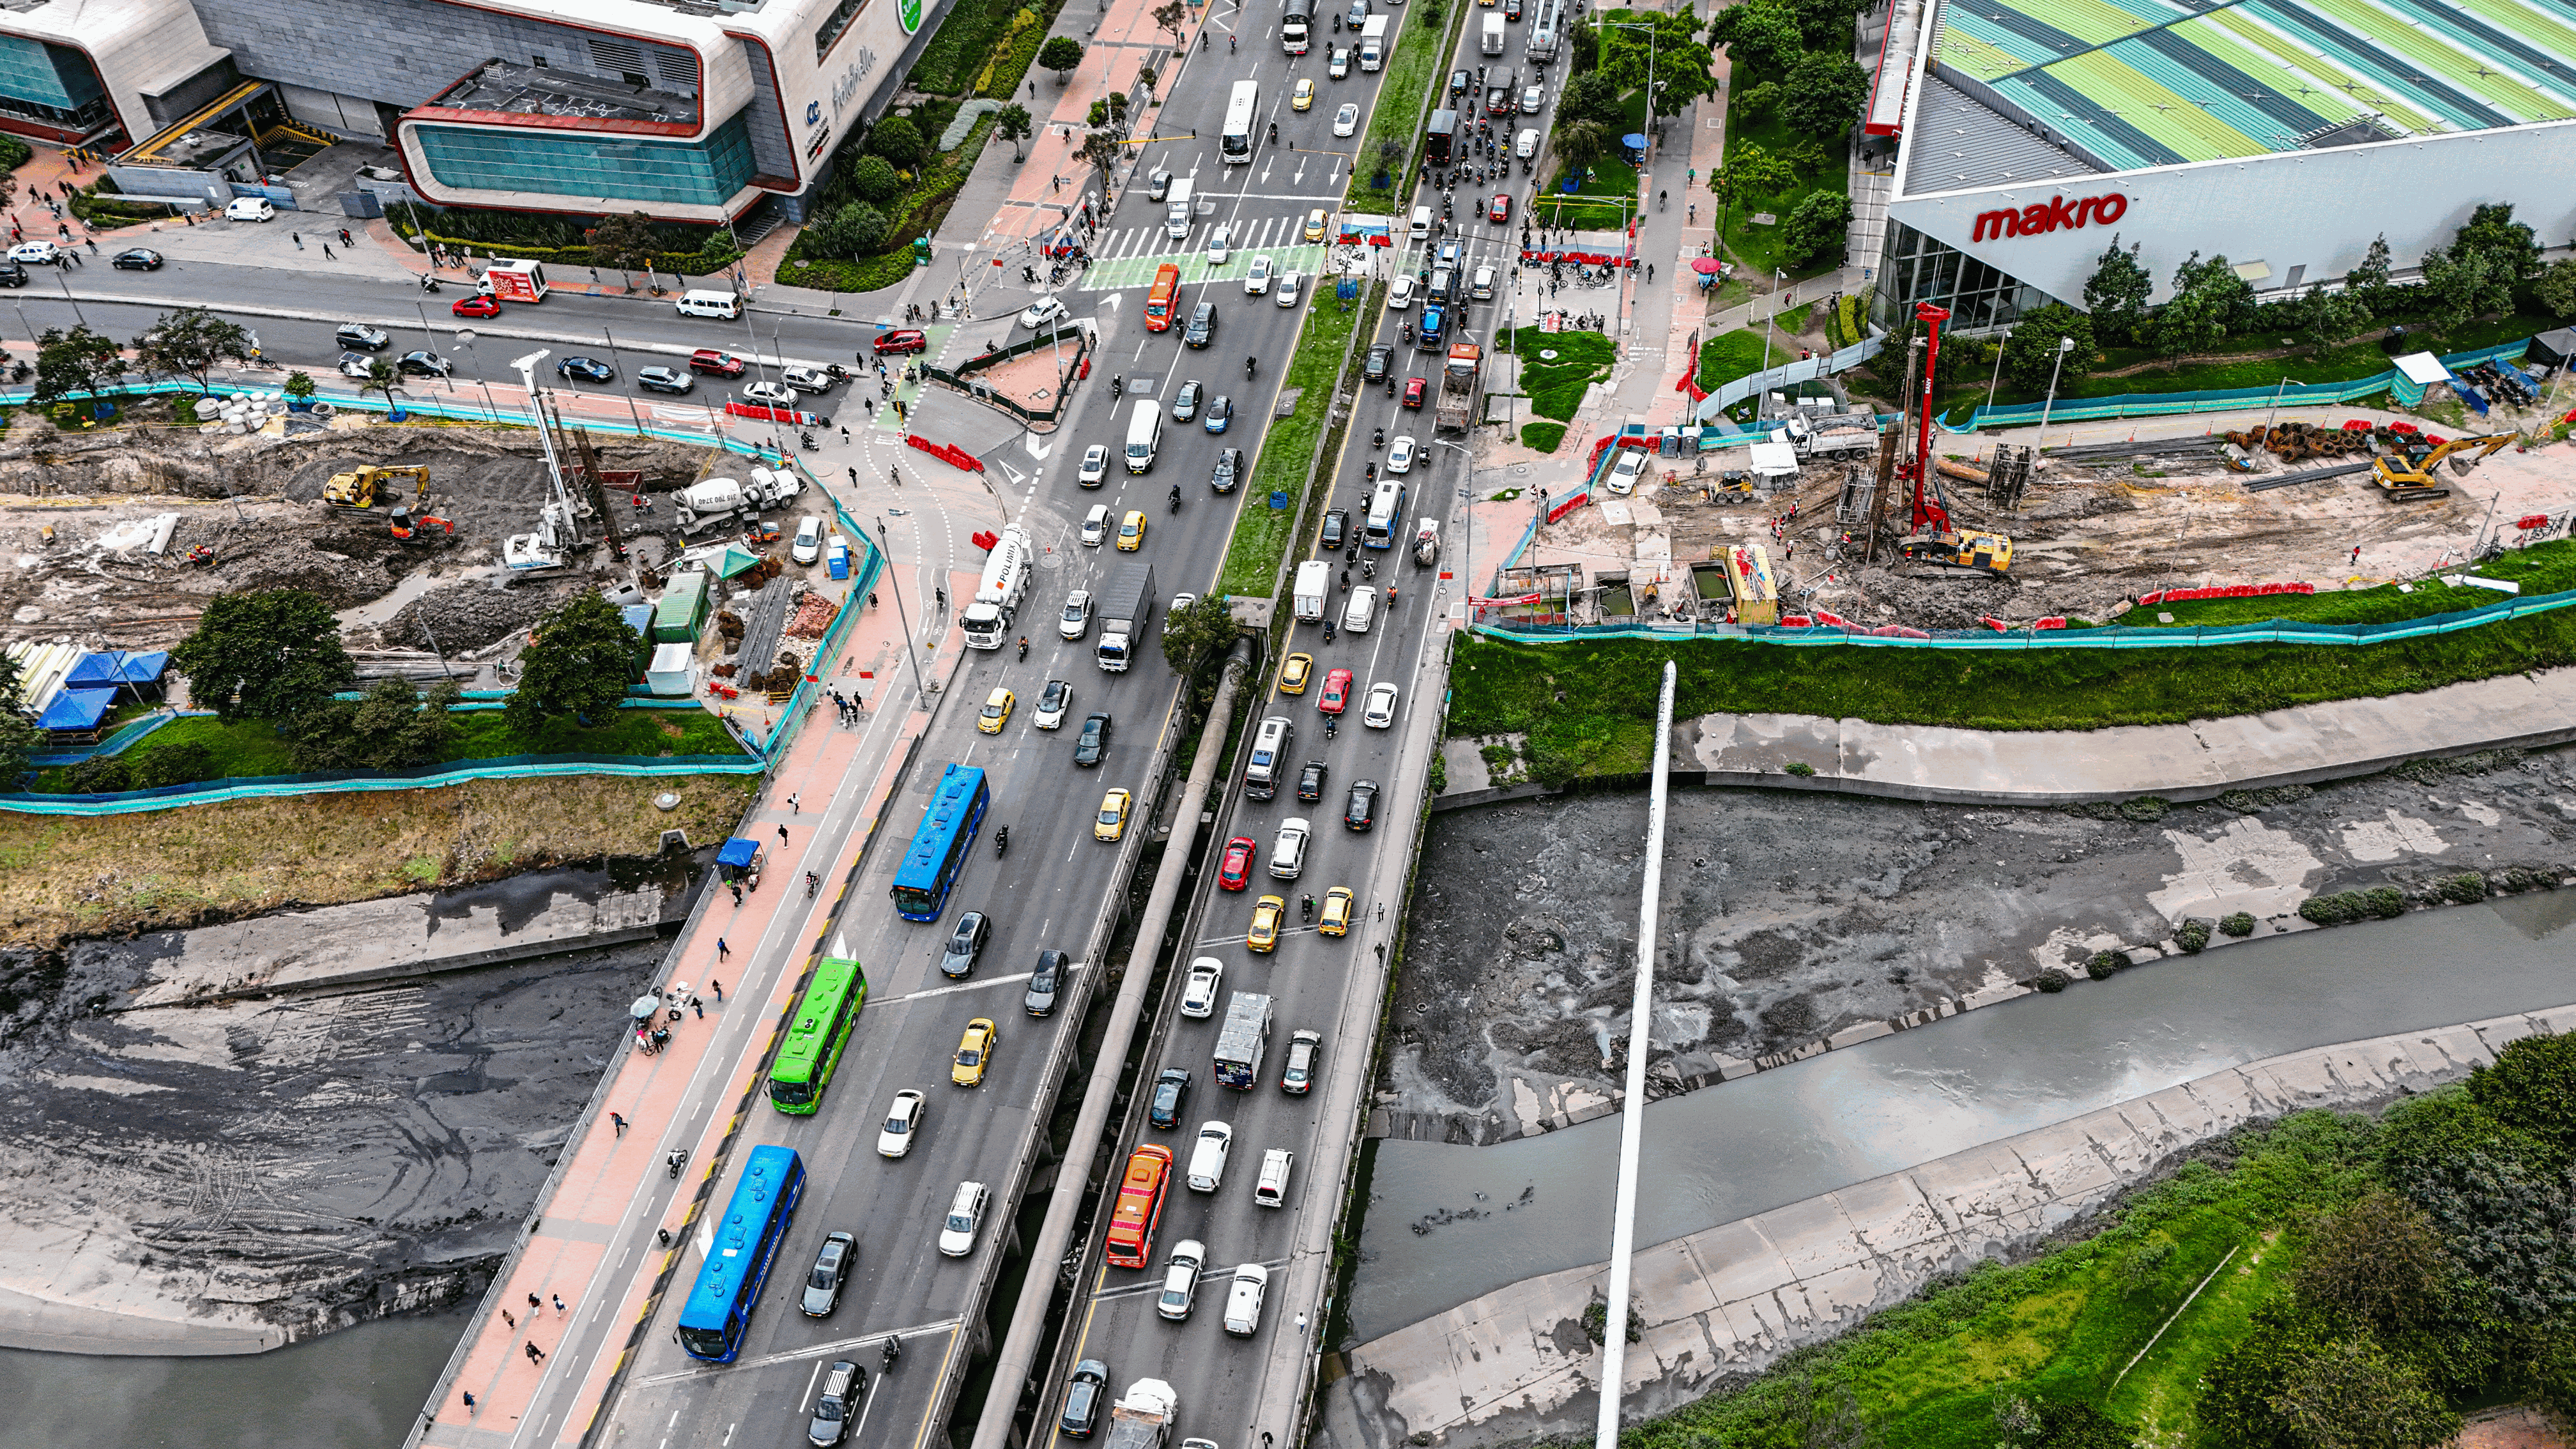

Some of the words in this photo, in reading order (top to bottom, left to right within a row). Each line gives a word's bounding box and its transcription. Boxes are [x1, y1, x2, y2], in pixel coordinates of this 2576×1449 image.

[1973, 193, 2128, 243] makro
[2373, 466, 2384, 480] CAT
[727, 494, 737, 502] 315
[999, 544, 1015, 582] POLIMIX
